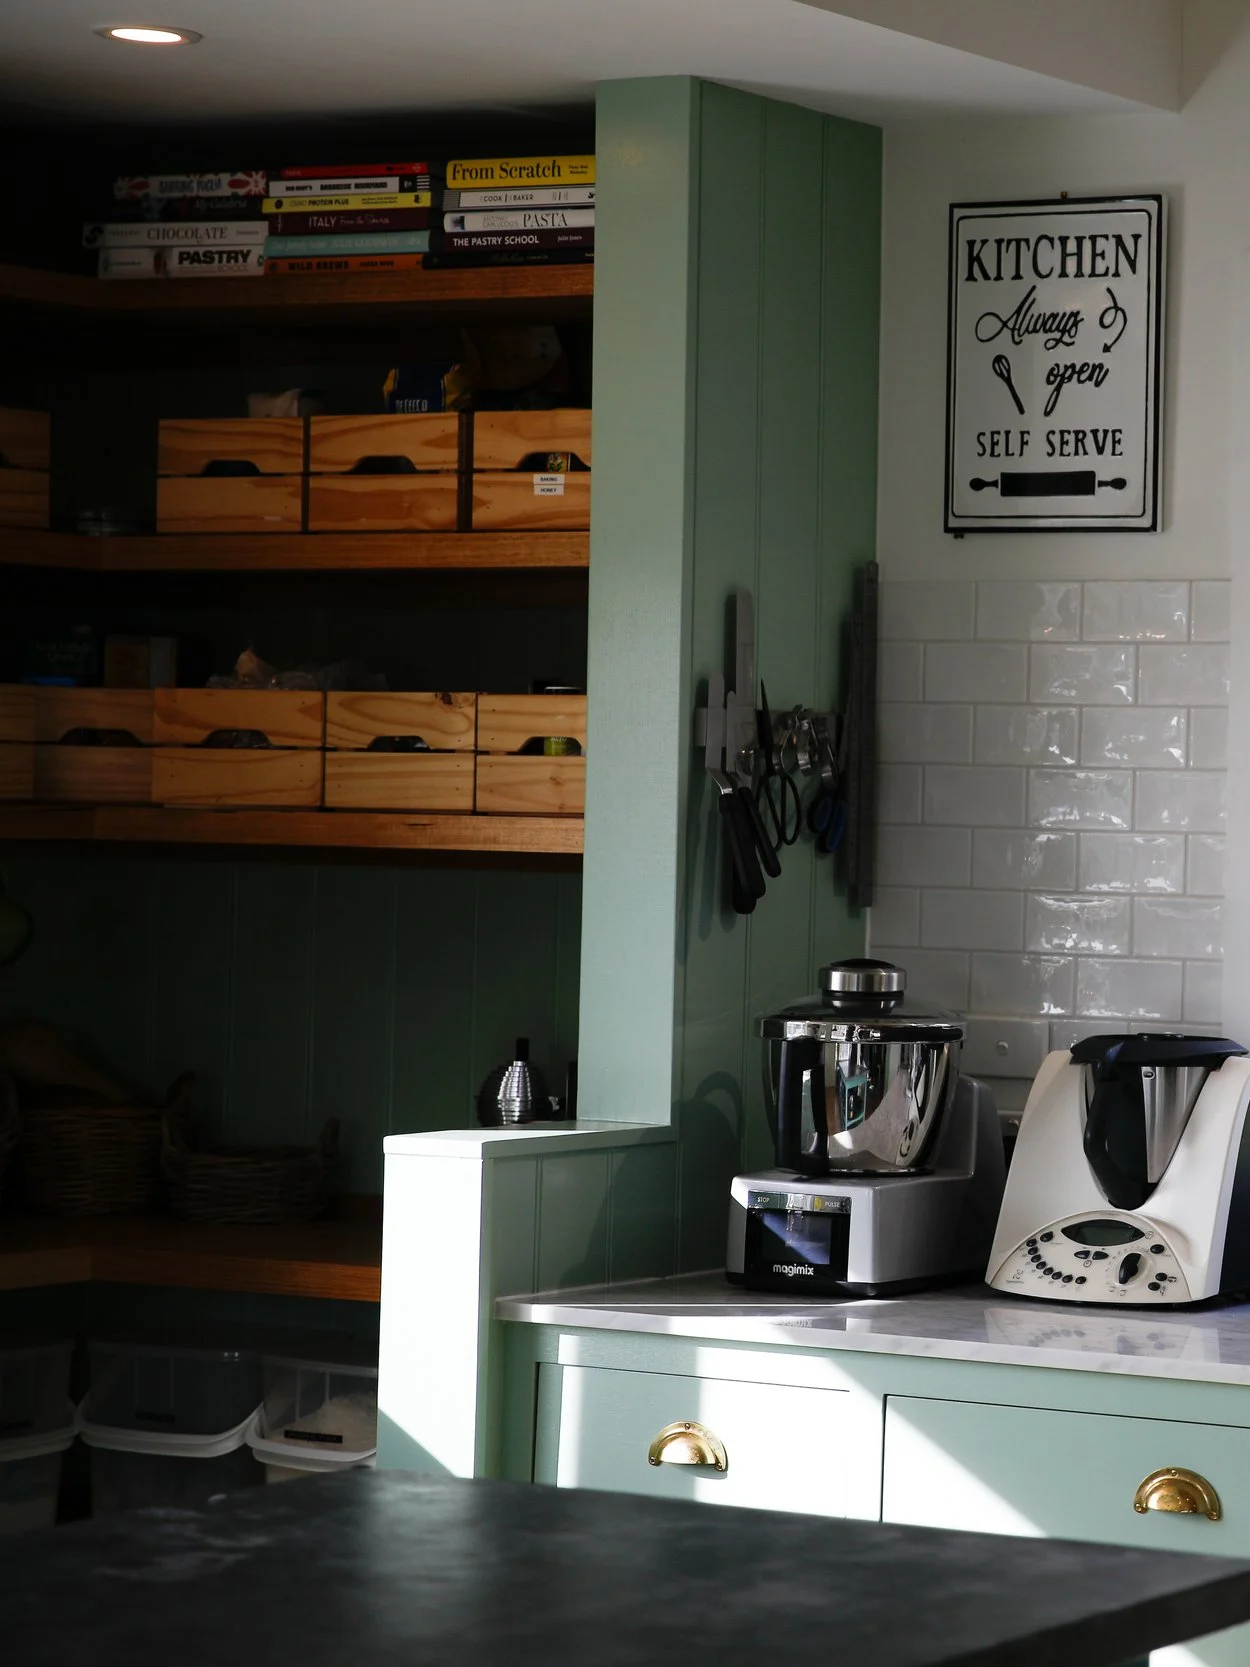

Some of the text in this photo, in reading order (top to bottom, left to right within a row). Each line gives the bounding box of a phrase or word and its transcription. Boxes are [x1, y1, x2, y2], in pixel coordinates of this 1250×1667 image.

[452, 163, 494, 181] From
[498, 160, 561, 180] Scratch
[308, 216, 337, 228] ITALY
[523, 212, 568, 228] PASTA
[147, 227, 228, 243] CHOCOLATE
[452, 235, 540, 247] THE PASTRY SCHOOL
[178, 250, 252, 265] PASTRY
[964, 233, 1142, 281] KITCHEN
[288, 261, 313, 271] WILD
[975, 284, 1084, 351] Always
[1043, 361, 1109, 417] open
[976, 428, 1123, 457] SELF SERVE
[773, 1263, 814, 1277] magimix
